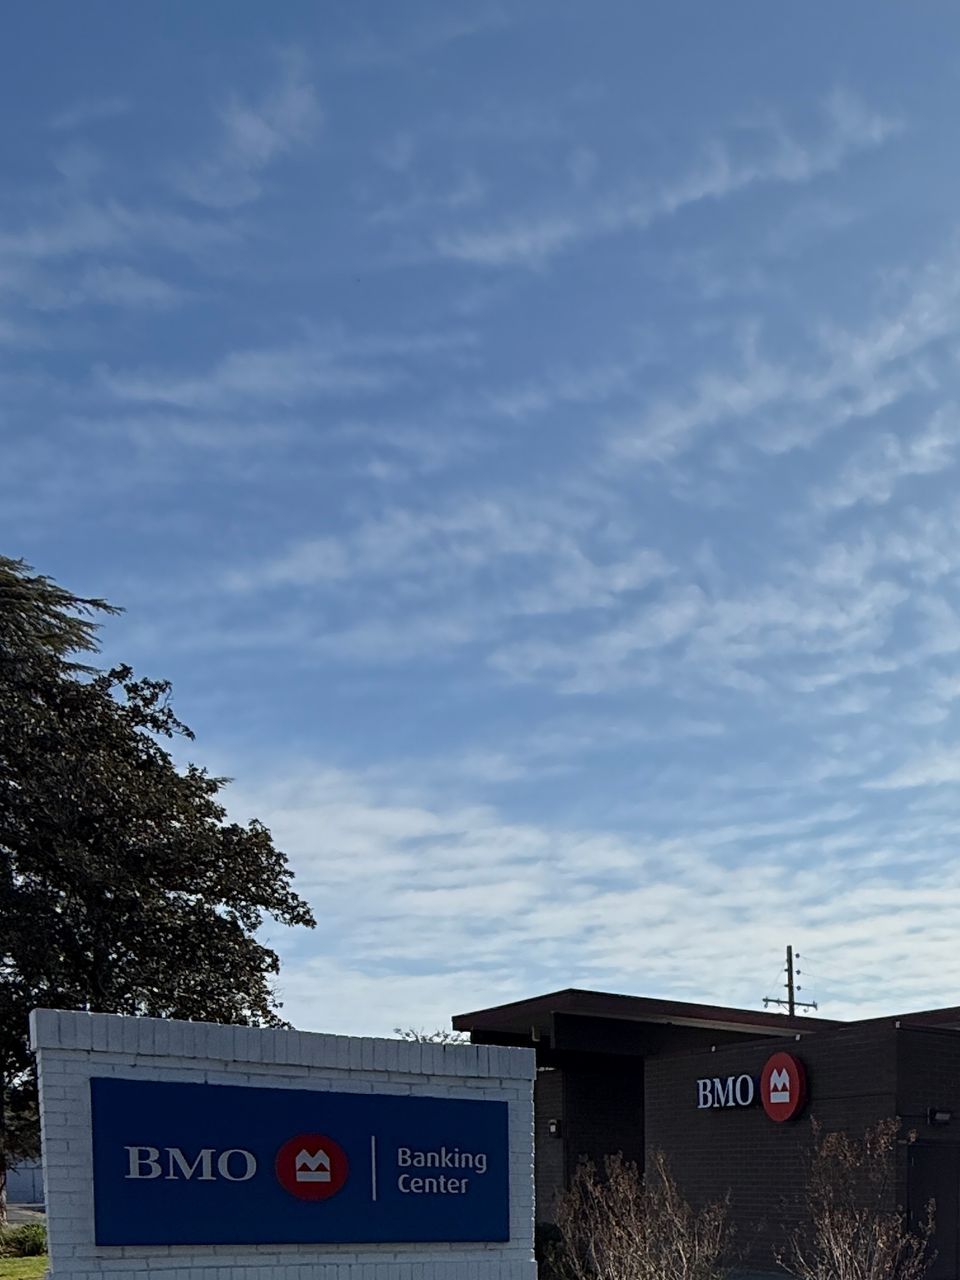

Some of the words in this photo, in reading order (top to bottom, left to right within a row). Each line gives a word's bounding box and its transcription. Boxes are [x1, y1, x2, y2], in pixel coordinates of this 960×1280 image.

[697, 1074, 754, 1109] BMO
[124, 1146, 257, 1181] BMO
[398, 1147, 487, 1174] Banking
[398, 1174, 469, 1194] Center
